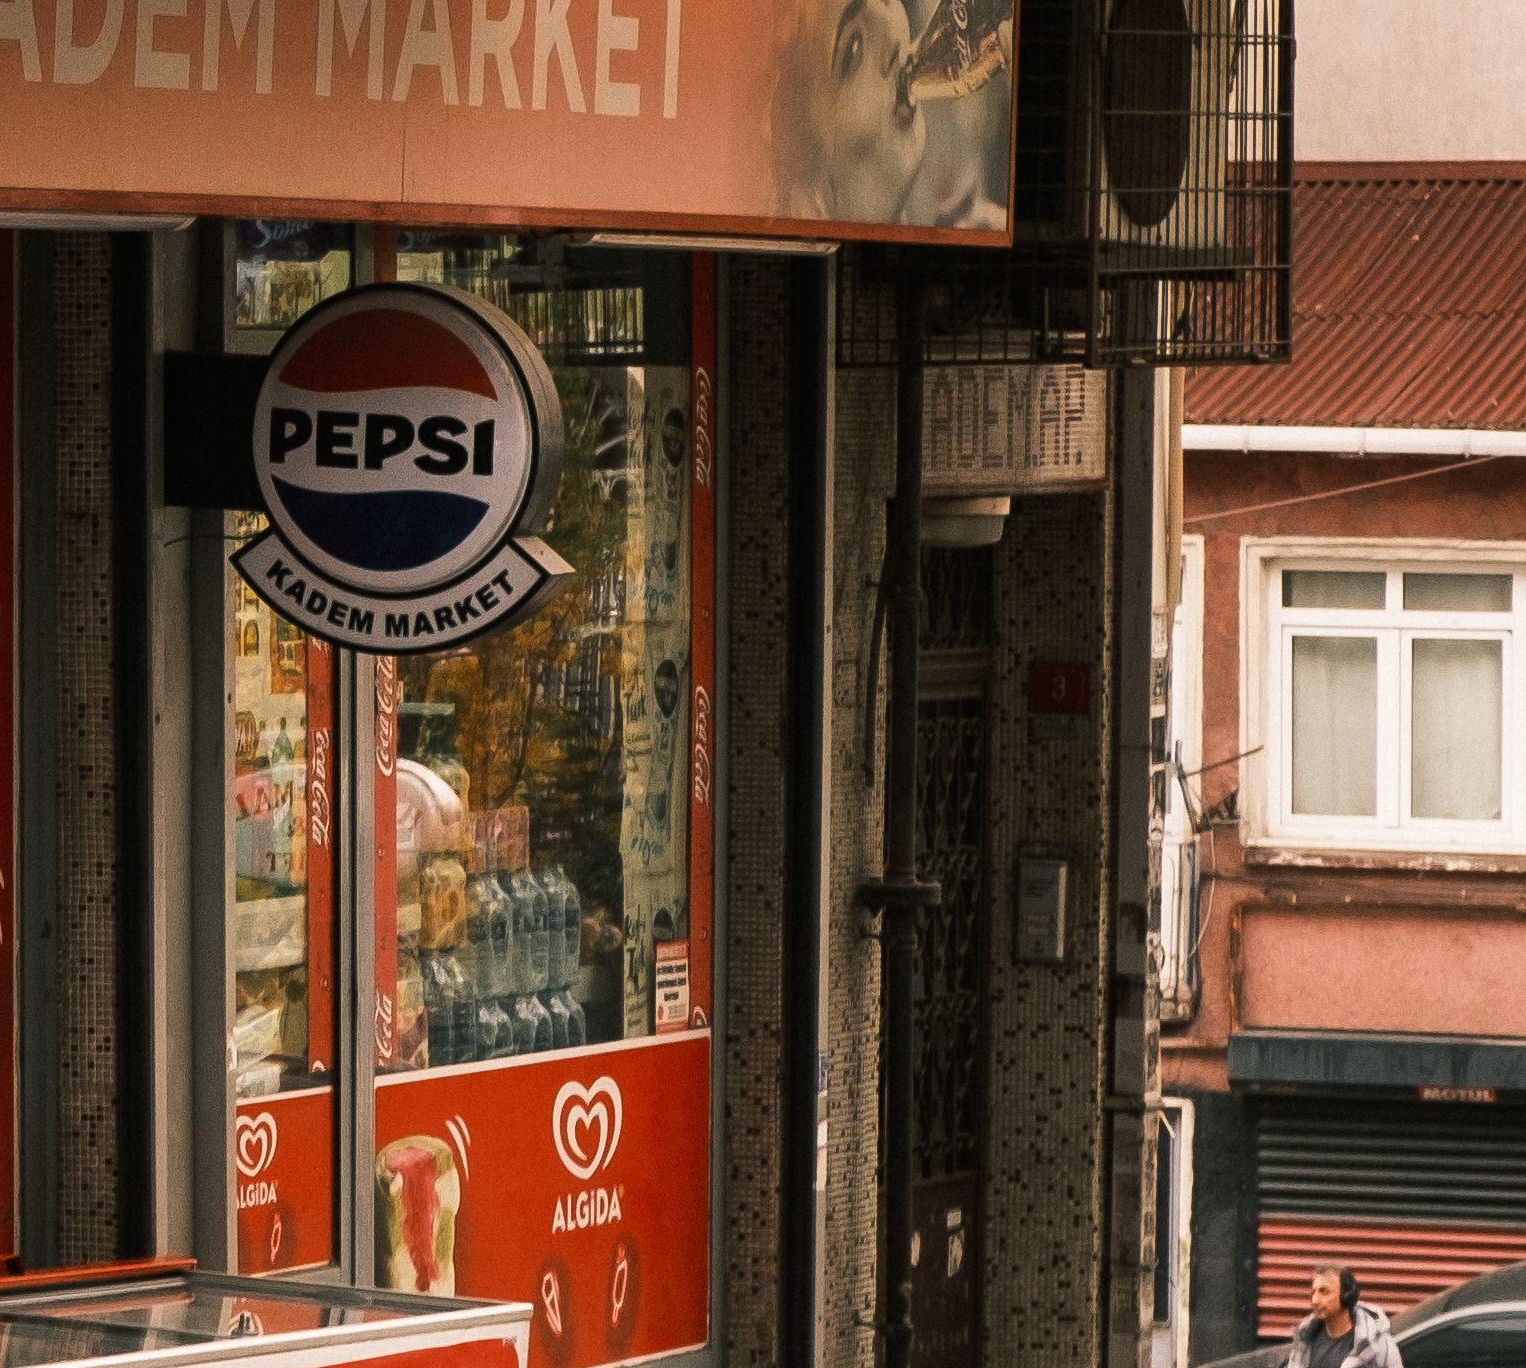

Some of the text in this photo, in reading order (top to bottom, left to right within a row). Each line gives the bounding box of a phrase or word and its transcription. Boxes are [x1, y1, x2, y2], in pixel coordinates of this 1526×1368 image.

[269, 406, 497, 478] PEPSI
[265, 556, 517, 639] KADEM MARKET
